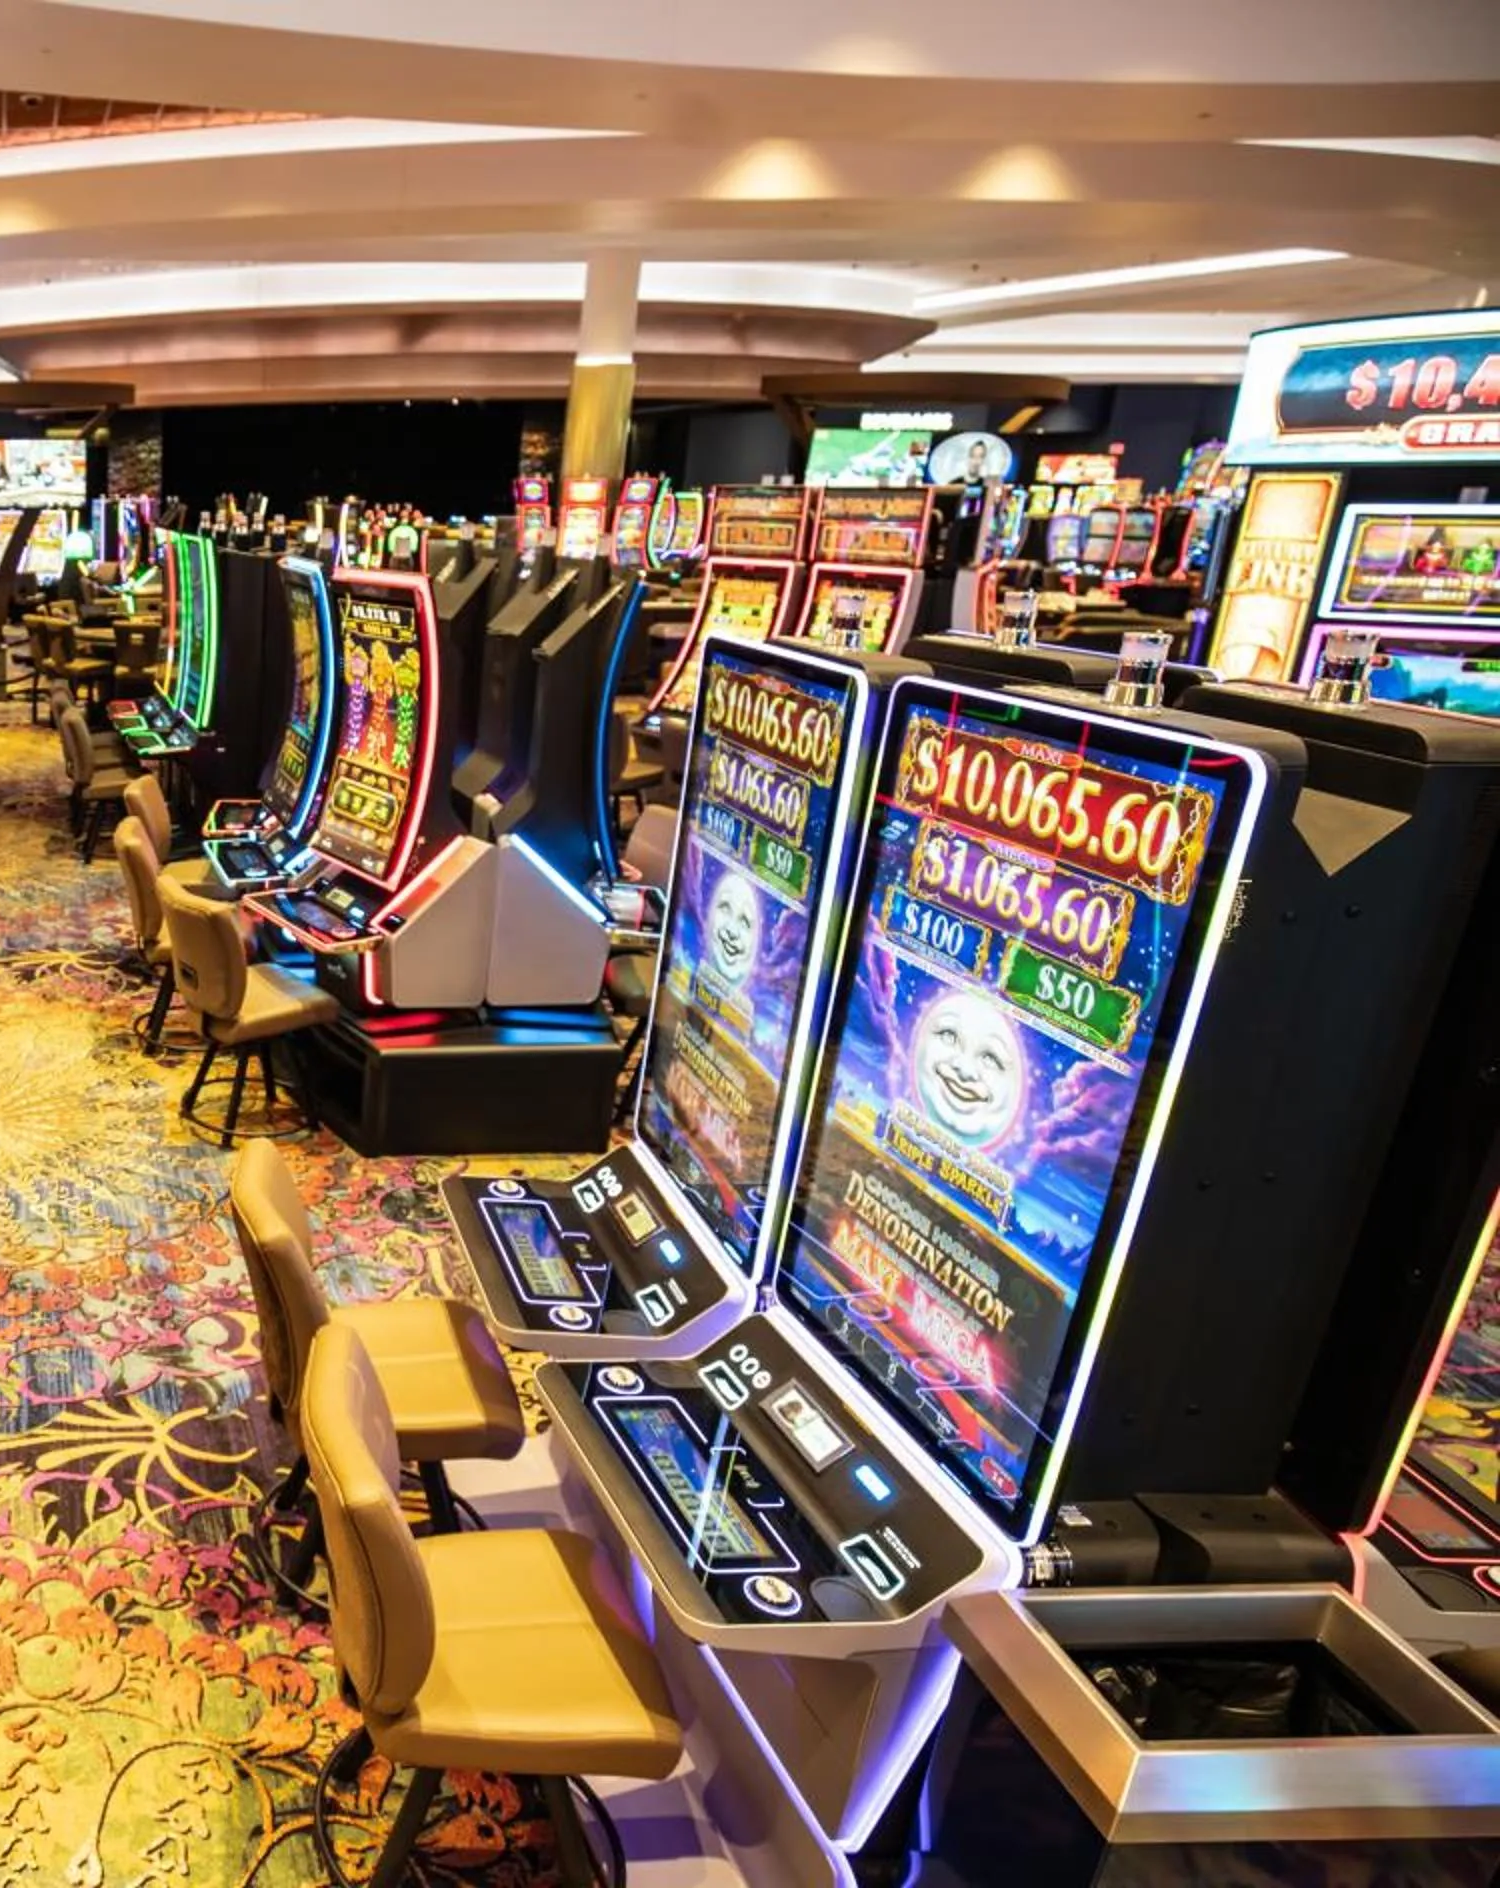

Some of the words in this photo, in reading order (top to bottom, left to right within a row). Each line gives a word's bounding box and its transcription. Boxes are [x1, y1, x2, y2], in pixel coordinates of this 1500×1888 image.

[712, 677, 831, 766] $10,065.60
[912, 737, 1182, 876] $10,065.60
[765, 841, 793, 878] $50
[923, 837, 1112, 953] $1,065.60
[903, 903, 964, 956] $100
[1036, 965, 1095, 1019] $50
[843, 1170, 1014, 1332] DENOMINATION
